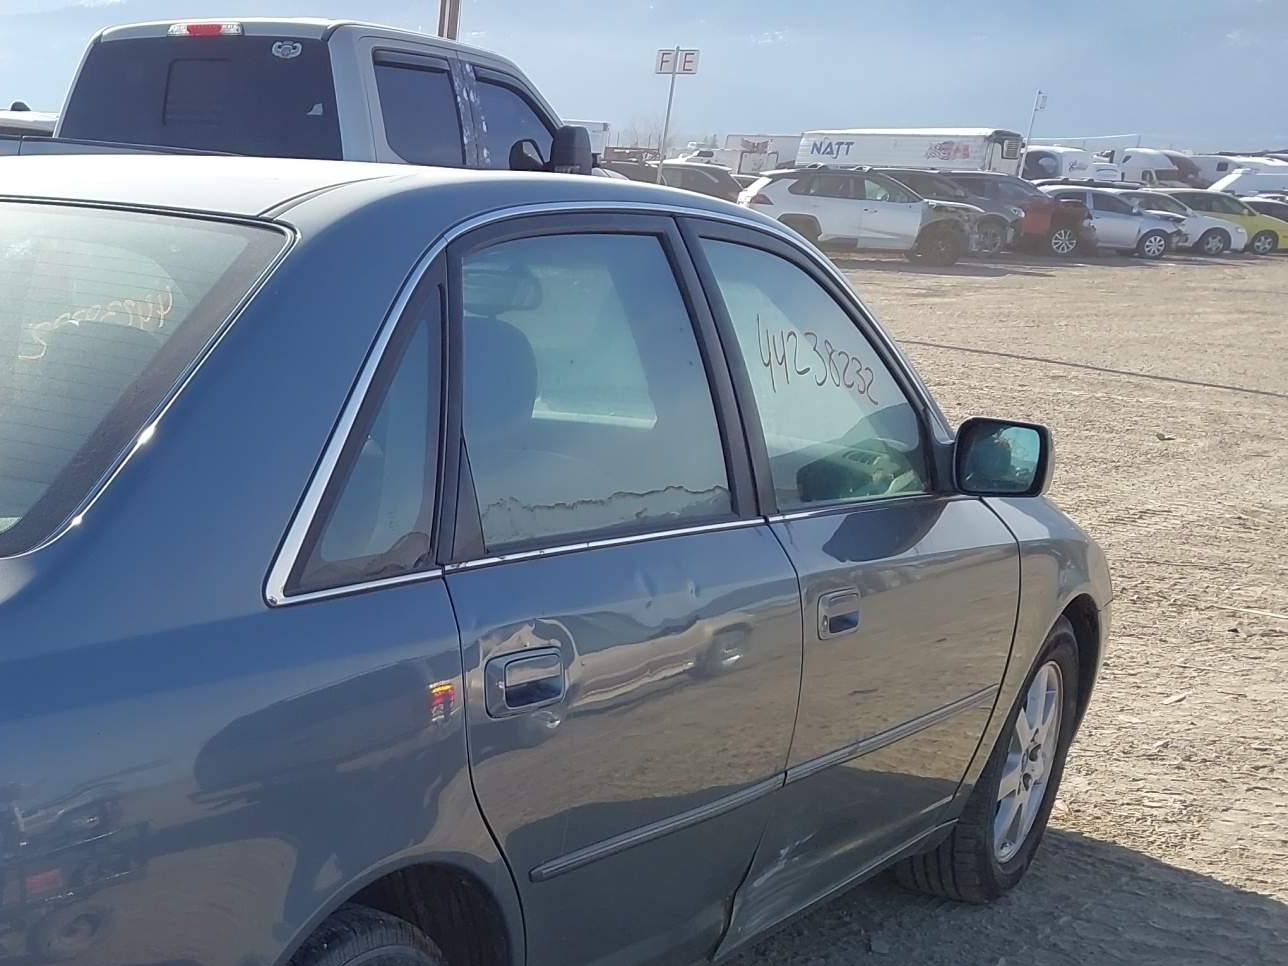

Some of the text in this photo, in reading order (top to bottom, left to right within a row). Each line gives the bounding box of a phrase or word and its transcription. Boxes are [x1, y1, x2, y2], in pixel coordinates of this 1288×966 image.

[659, 52, 696, 72] F E
[756, 312, 879, 406] 44238232
